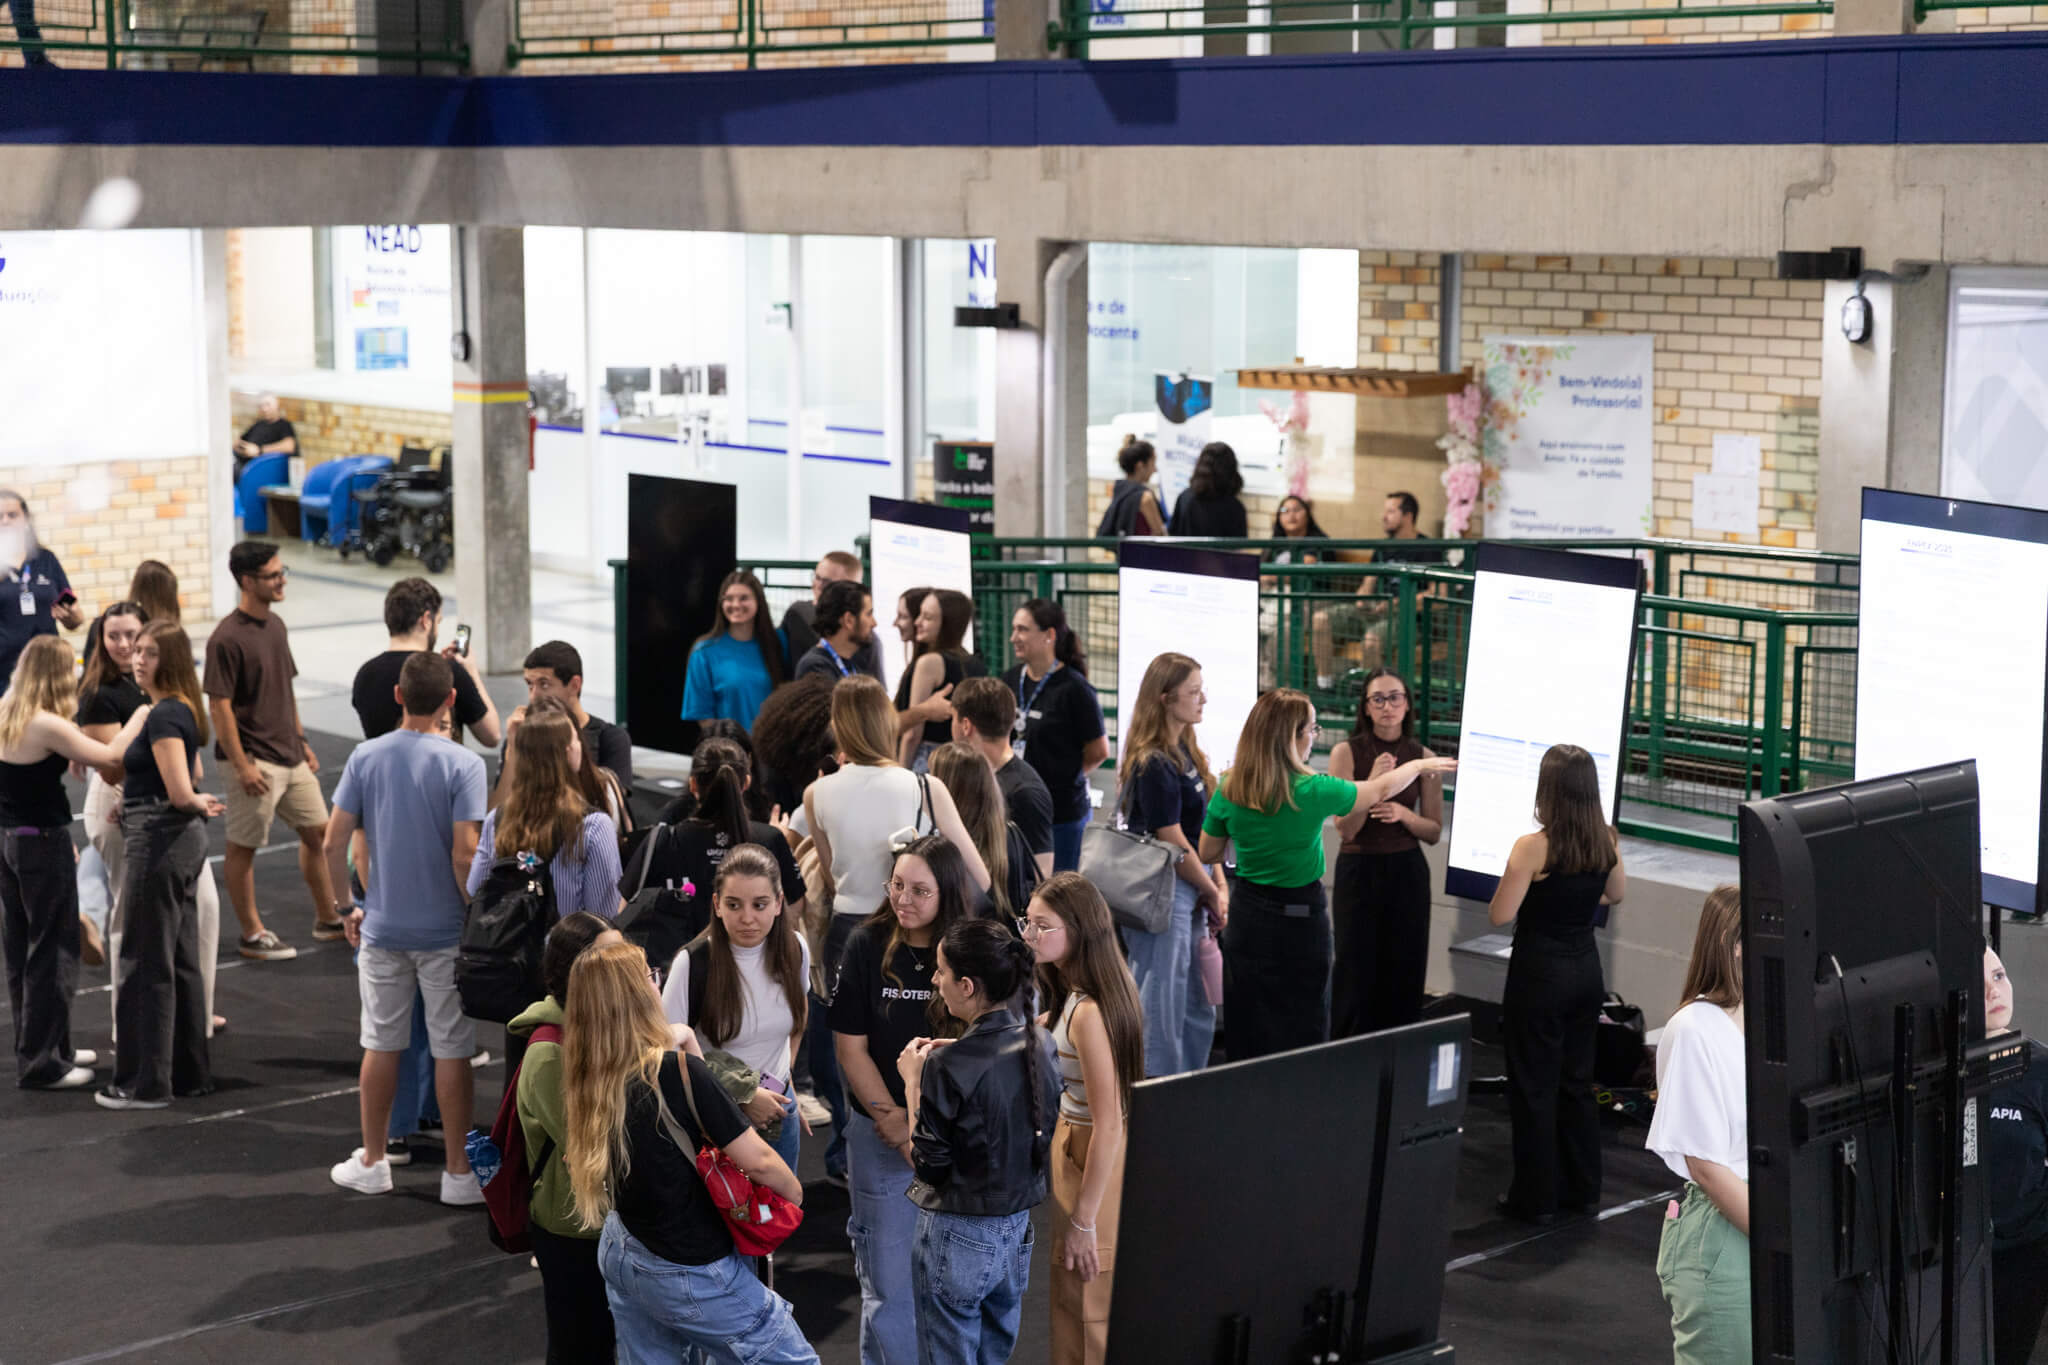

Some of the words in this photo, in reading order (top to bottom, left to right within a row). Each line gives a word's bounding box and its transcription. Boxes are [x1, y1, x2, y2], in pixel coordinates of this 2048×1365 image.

[365, 225, 422, 253] NEAD
[968, 243, 996, 279] N
[882, 987, 937, 1000] FISOTER
[1990, 1107, 2022, 1121] APIA
